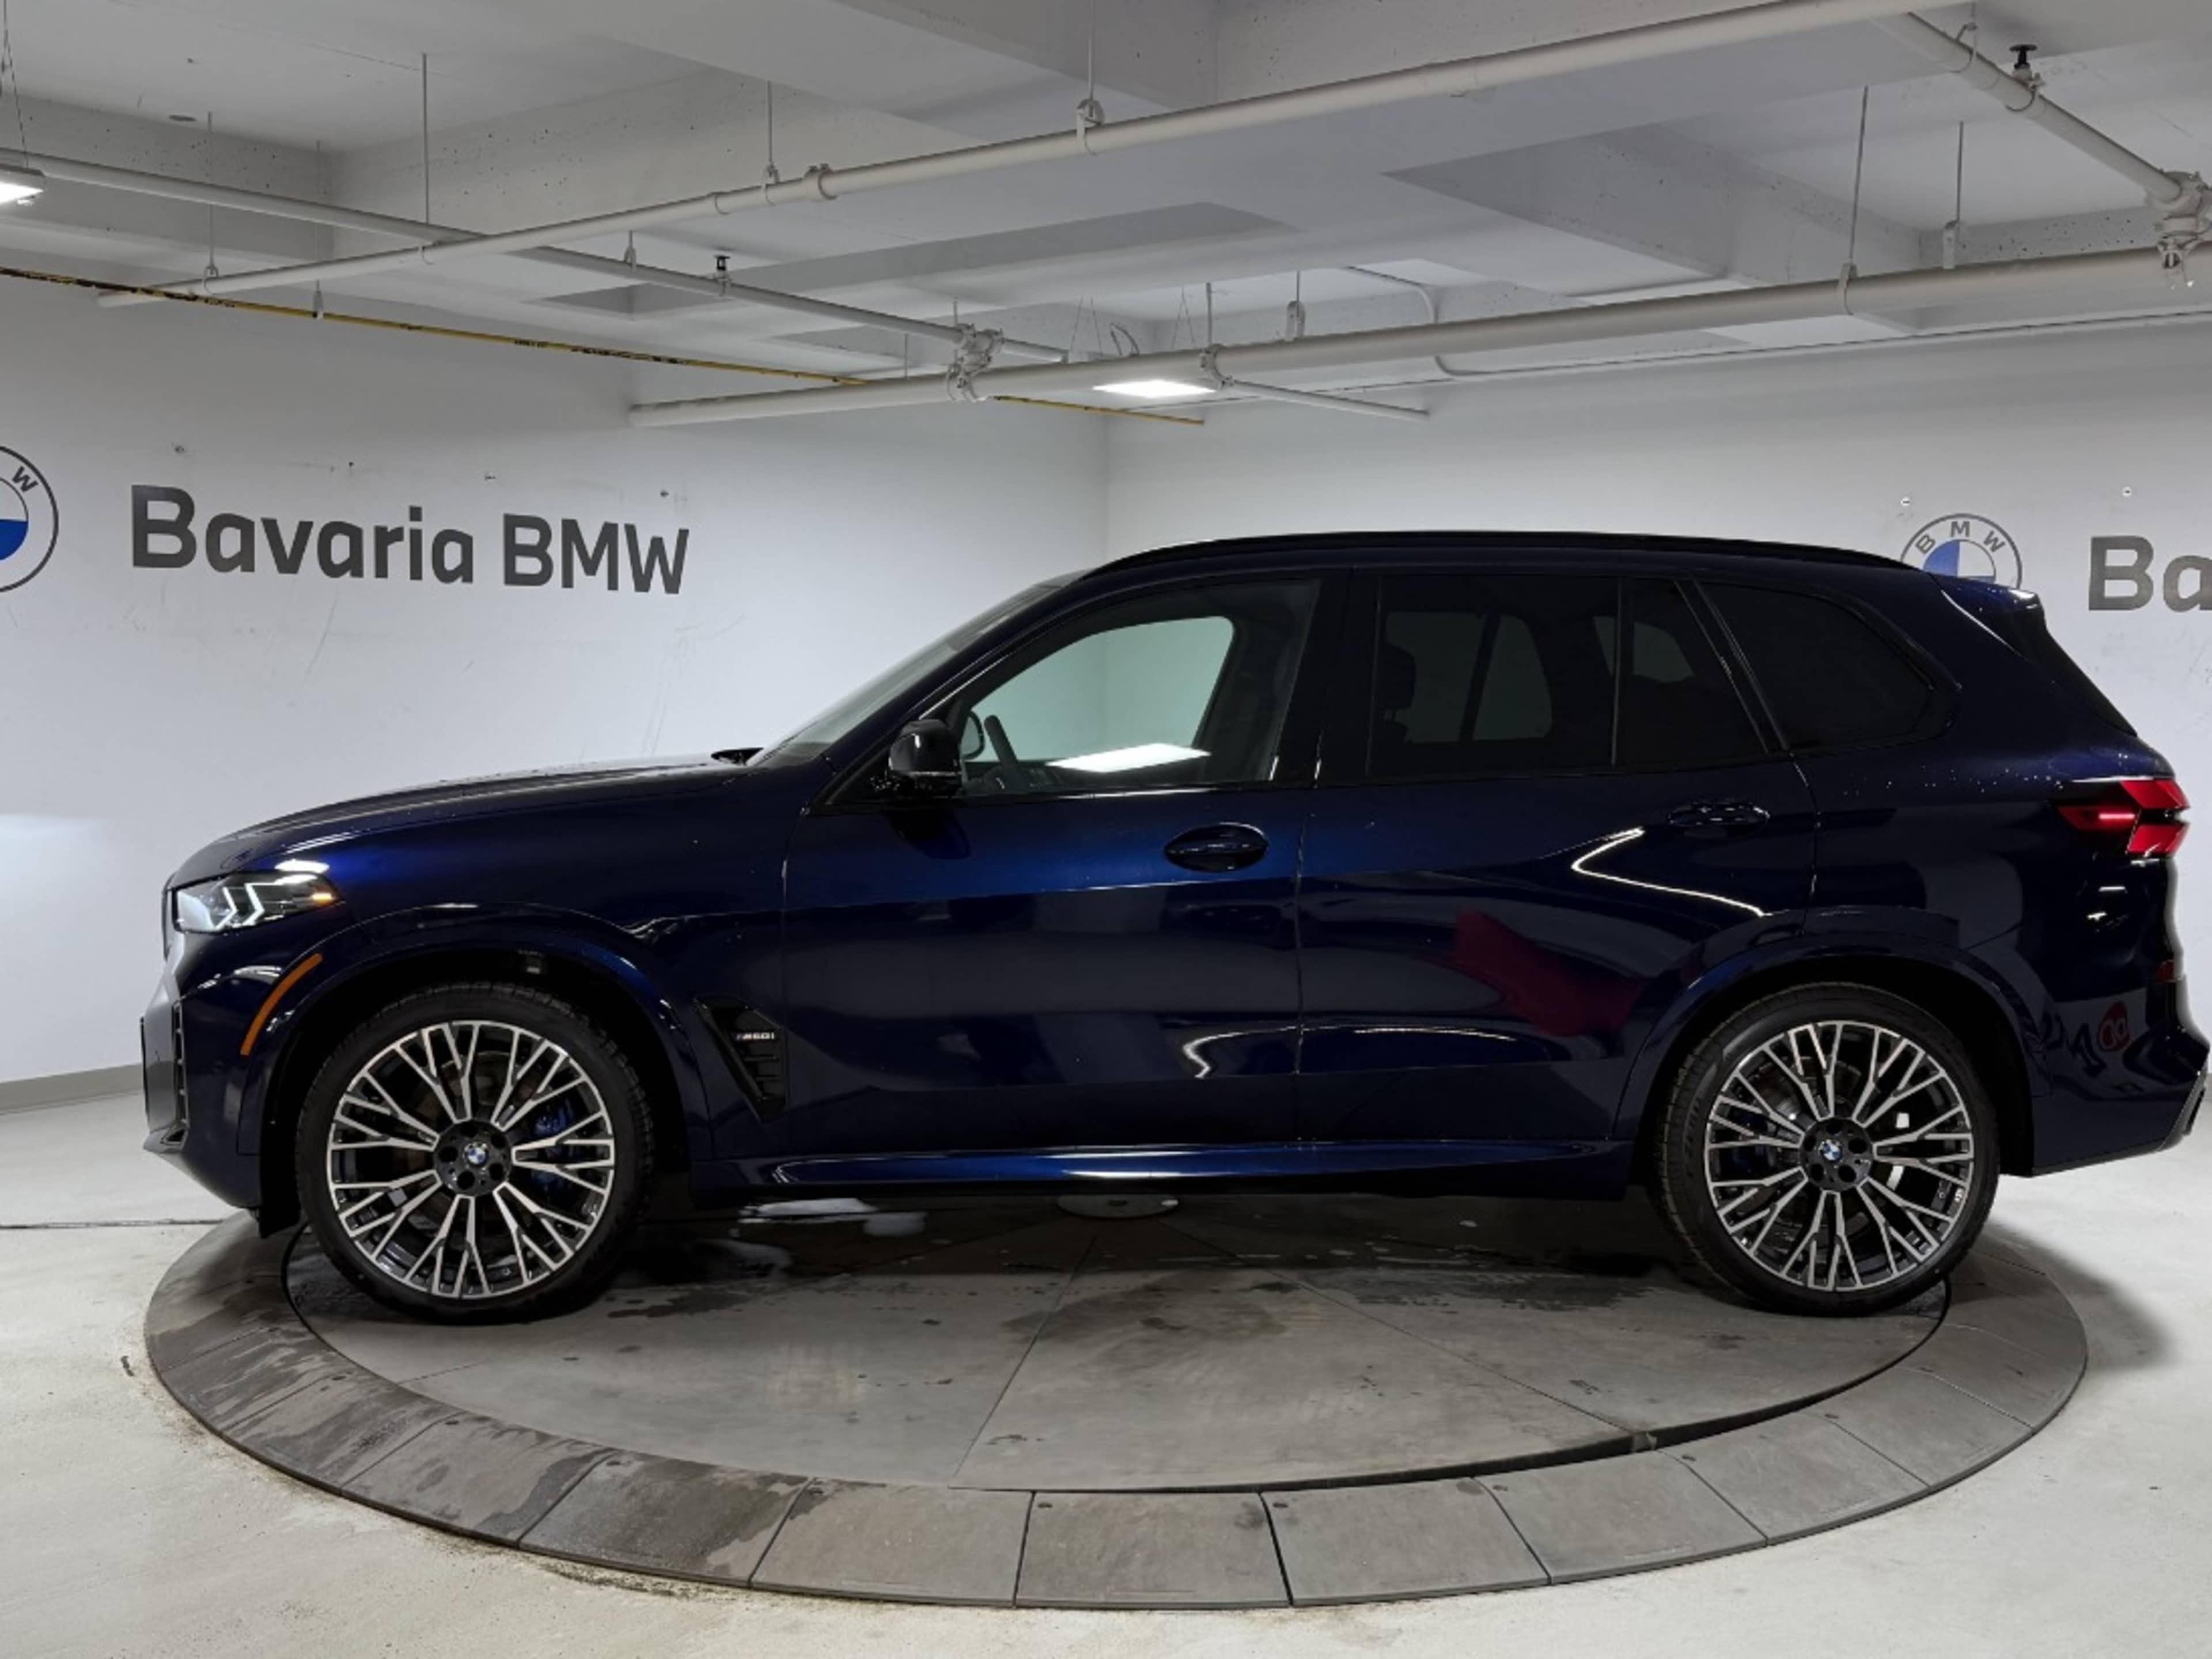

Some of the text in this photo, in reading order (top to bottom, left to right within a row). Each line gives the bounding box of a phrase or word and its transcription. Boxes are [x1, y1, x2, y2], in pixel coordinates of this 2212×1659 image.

[131, 484, 689, 594] Bavaria BMW
[1915, 521, 2006, 554] BMW
